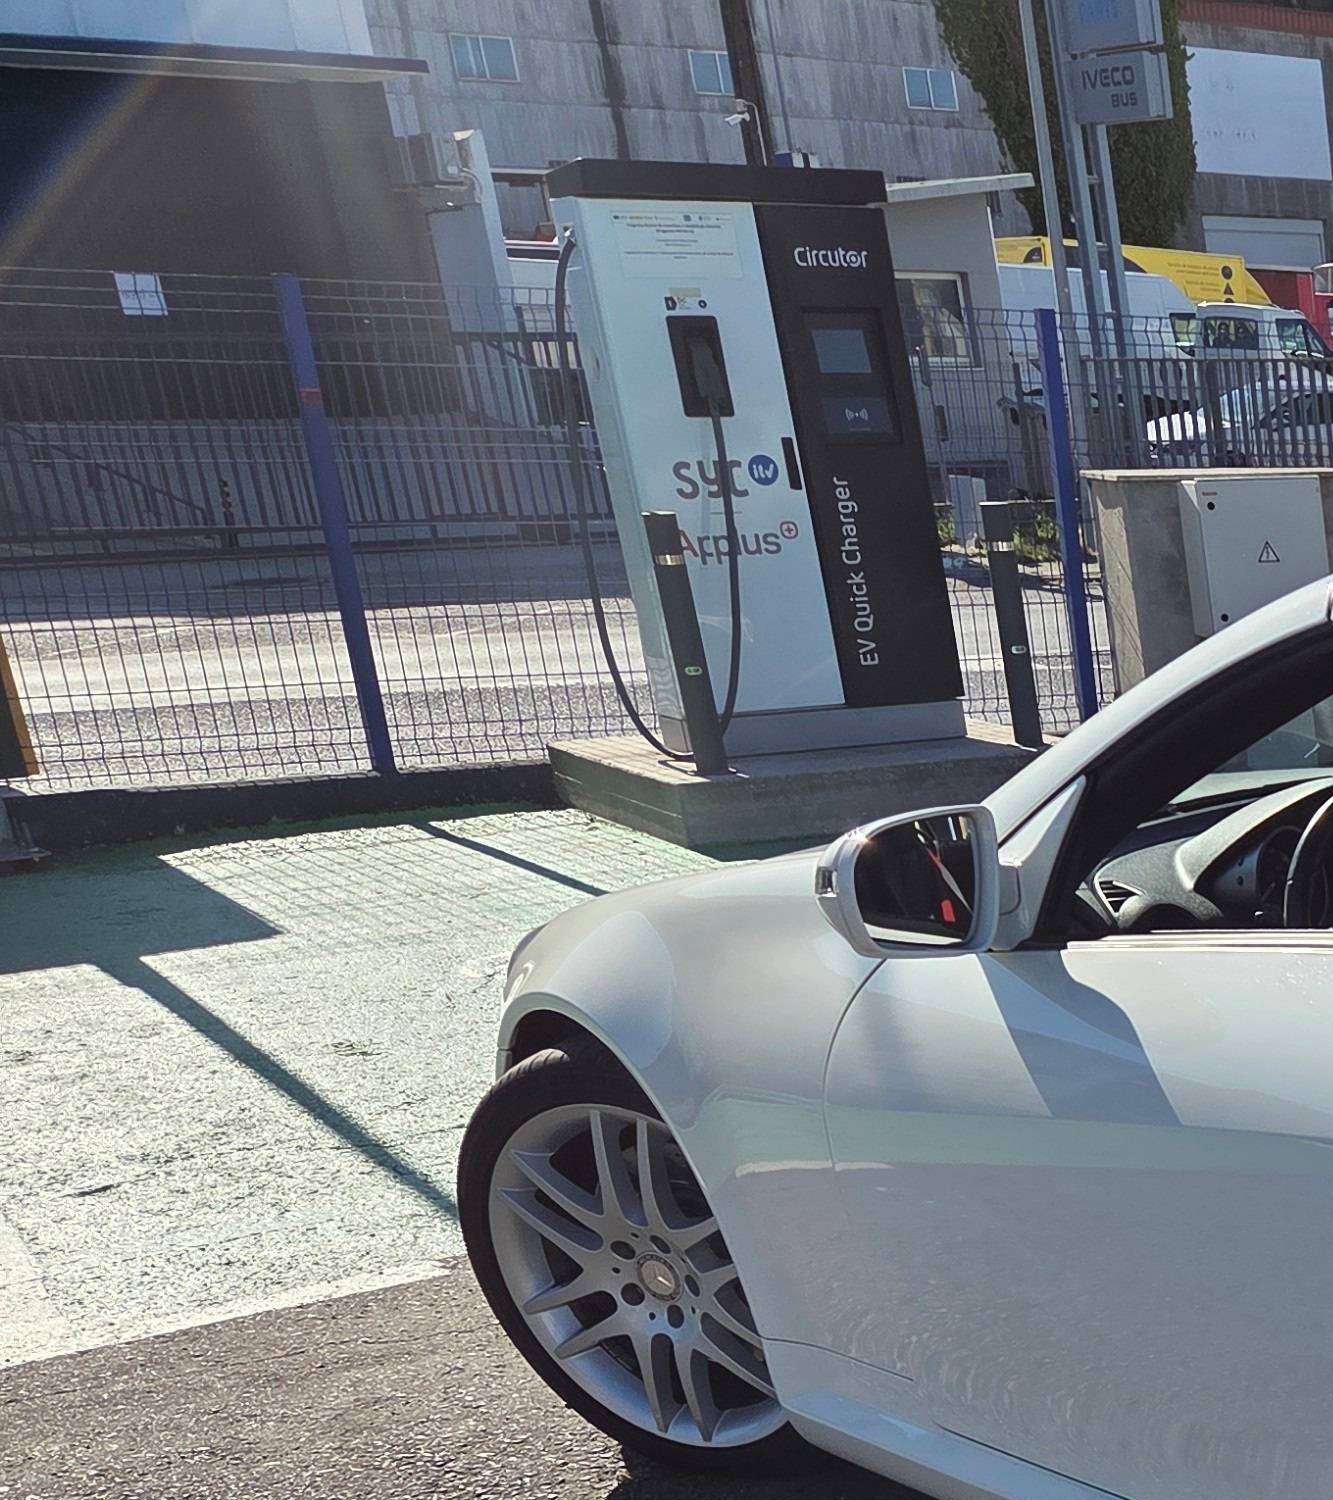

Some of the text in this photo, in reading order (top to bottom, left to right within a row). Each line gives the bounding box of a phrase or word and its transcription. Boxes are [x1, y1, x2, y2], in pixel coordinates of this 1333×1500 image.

[1080, 65, 1136, 91] IVECO
[1110, 91, 1138, 108] BUS
[793, 246, 868, 268] Circutor
[832, 475, 879, 667] EV Quick Charger
